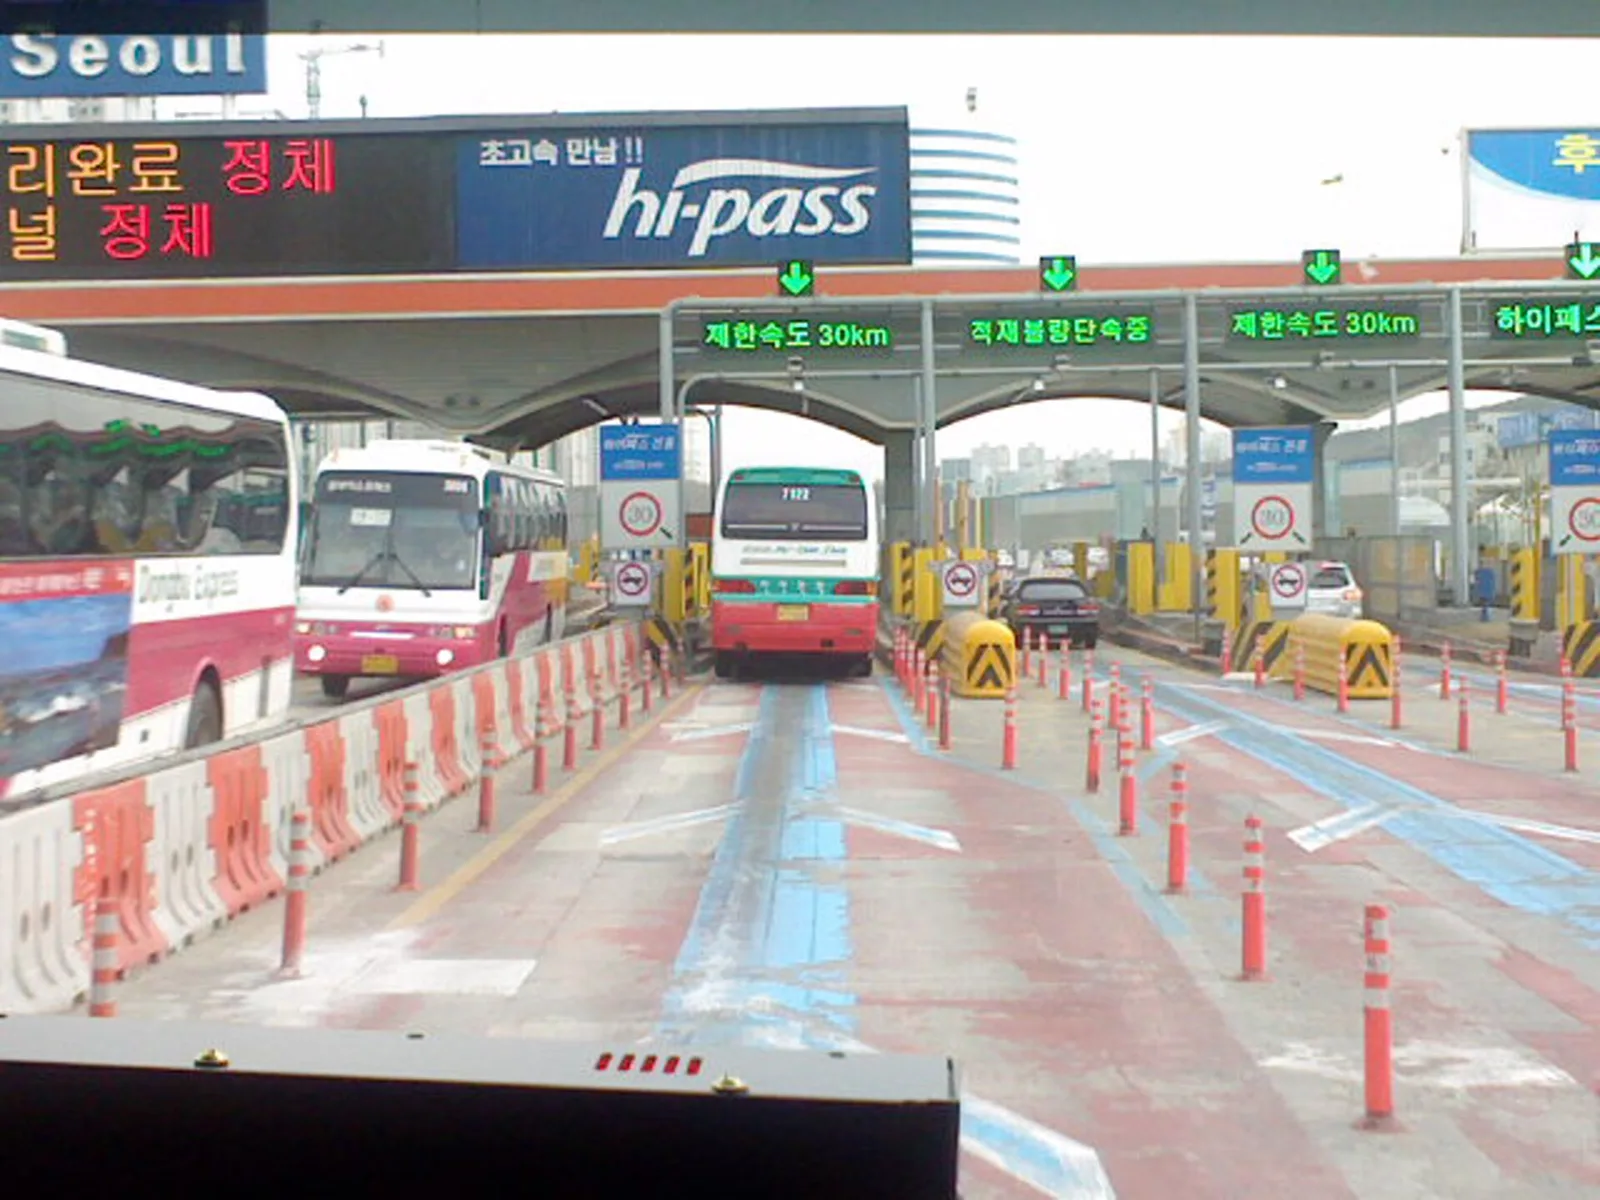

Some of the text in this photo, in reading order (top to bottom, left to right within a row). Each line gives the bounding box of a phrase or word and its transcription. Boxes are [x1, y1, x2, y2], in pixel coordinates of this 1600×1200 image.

[10, 33, 245, 77] Seoul
[7, 139, 336, 198] 리완료 정체
[479, 138, 558, 166] 초고속
[603, 159, 877, 256] hi-pass
[8, 203, 215, 261] 널 정체
[704, 322, 889, 350] 제한속도 30km
[1232, 311, 1417, 339] 제한속도 30km
[627, 503, 655, 524] 30
